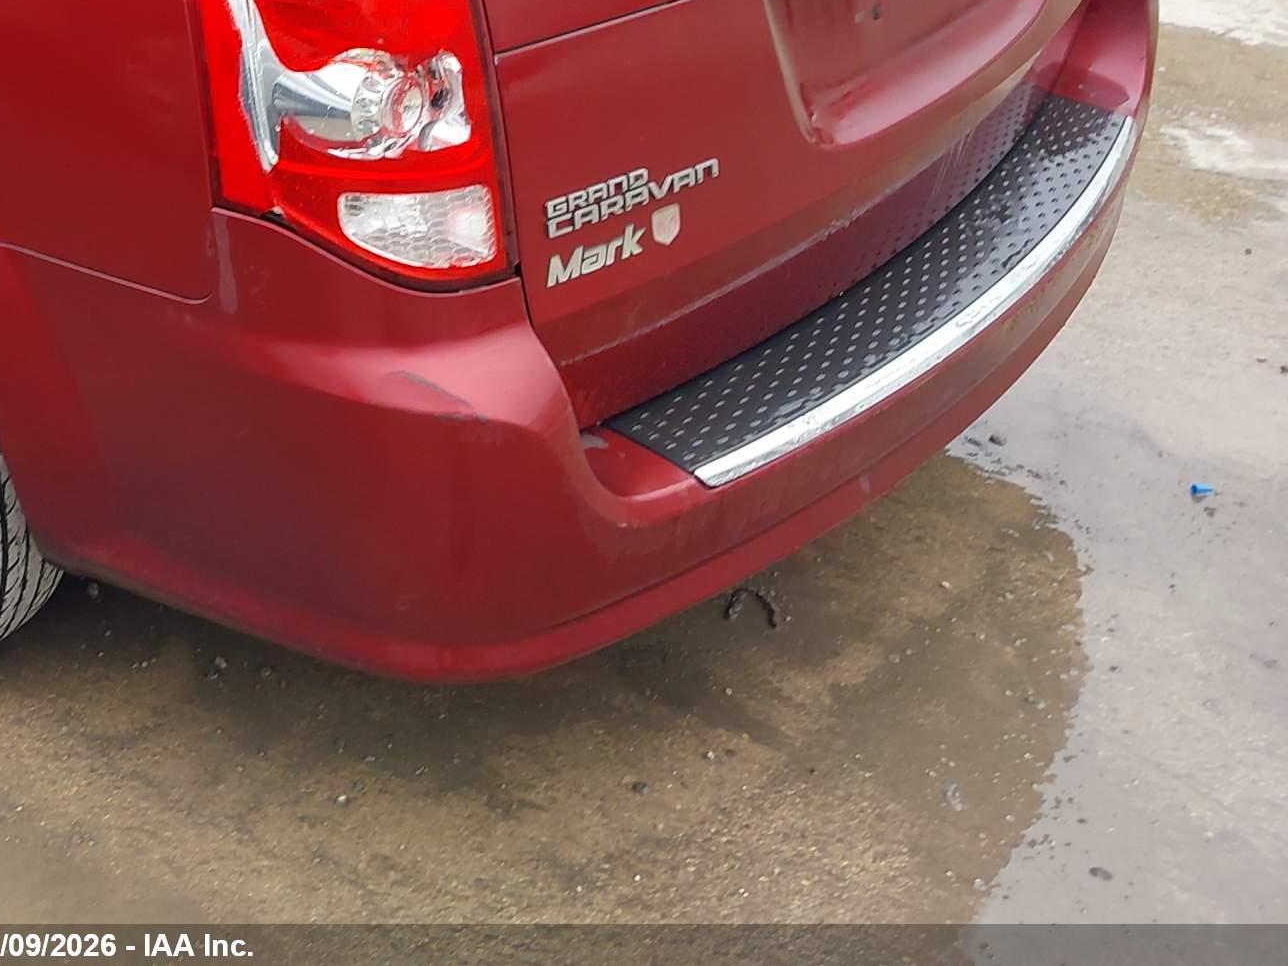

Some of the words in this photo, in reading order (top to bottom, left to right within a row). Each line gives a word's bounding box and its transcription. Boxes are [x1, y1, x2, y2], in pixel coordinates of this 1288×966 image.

[545, 167, 649, 219] GRAND
[546, 157, 720, 240] CARAVAN
[545, 223, 647, 289] Mark
